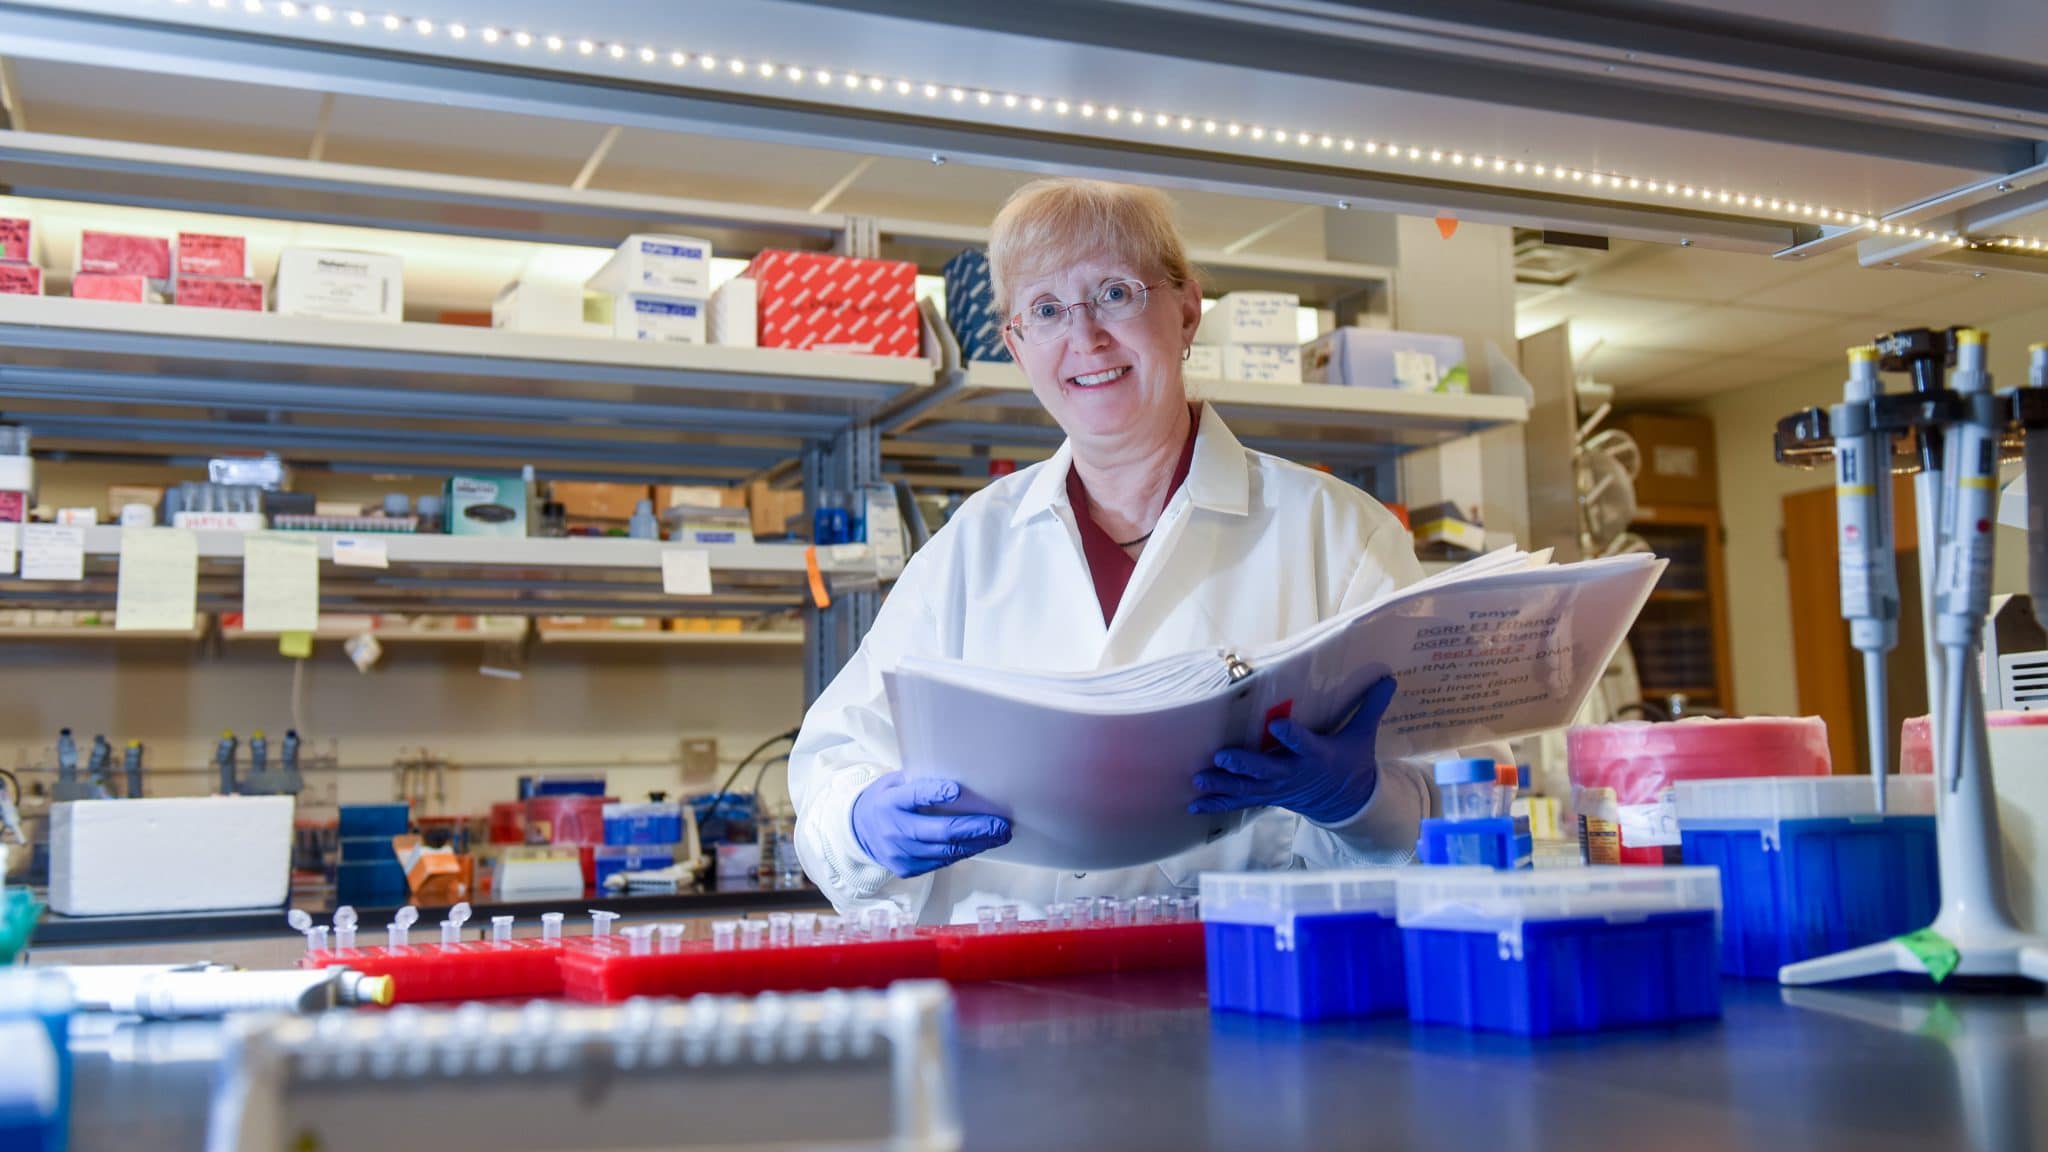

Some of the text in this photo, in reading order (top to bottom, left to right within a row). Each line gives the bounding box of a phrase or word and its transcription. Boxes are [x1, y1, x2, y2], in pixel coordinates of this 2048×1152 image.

[1922, 401, 1936, 420] 7
[1795, 422, 1807, 440] 6
[1469, 608, 1520, 620] Tanya
[1416, 624, 1466, 638] DGRP
[1411, 636, 1462, 651] DGRP
[1454, 670, 1500, 682] sexes
[1402, 686, 1443, 697] Total
[1445, 682, 1485, 692] lines
[1418, 696, 1458, 706] June
